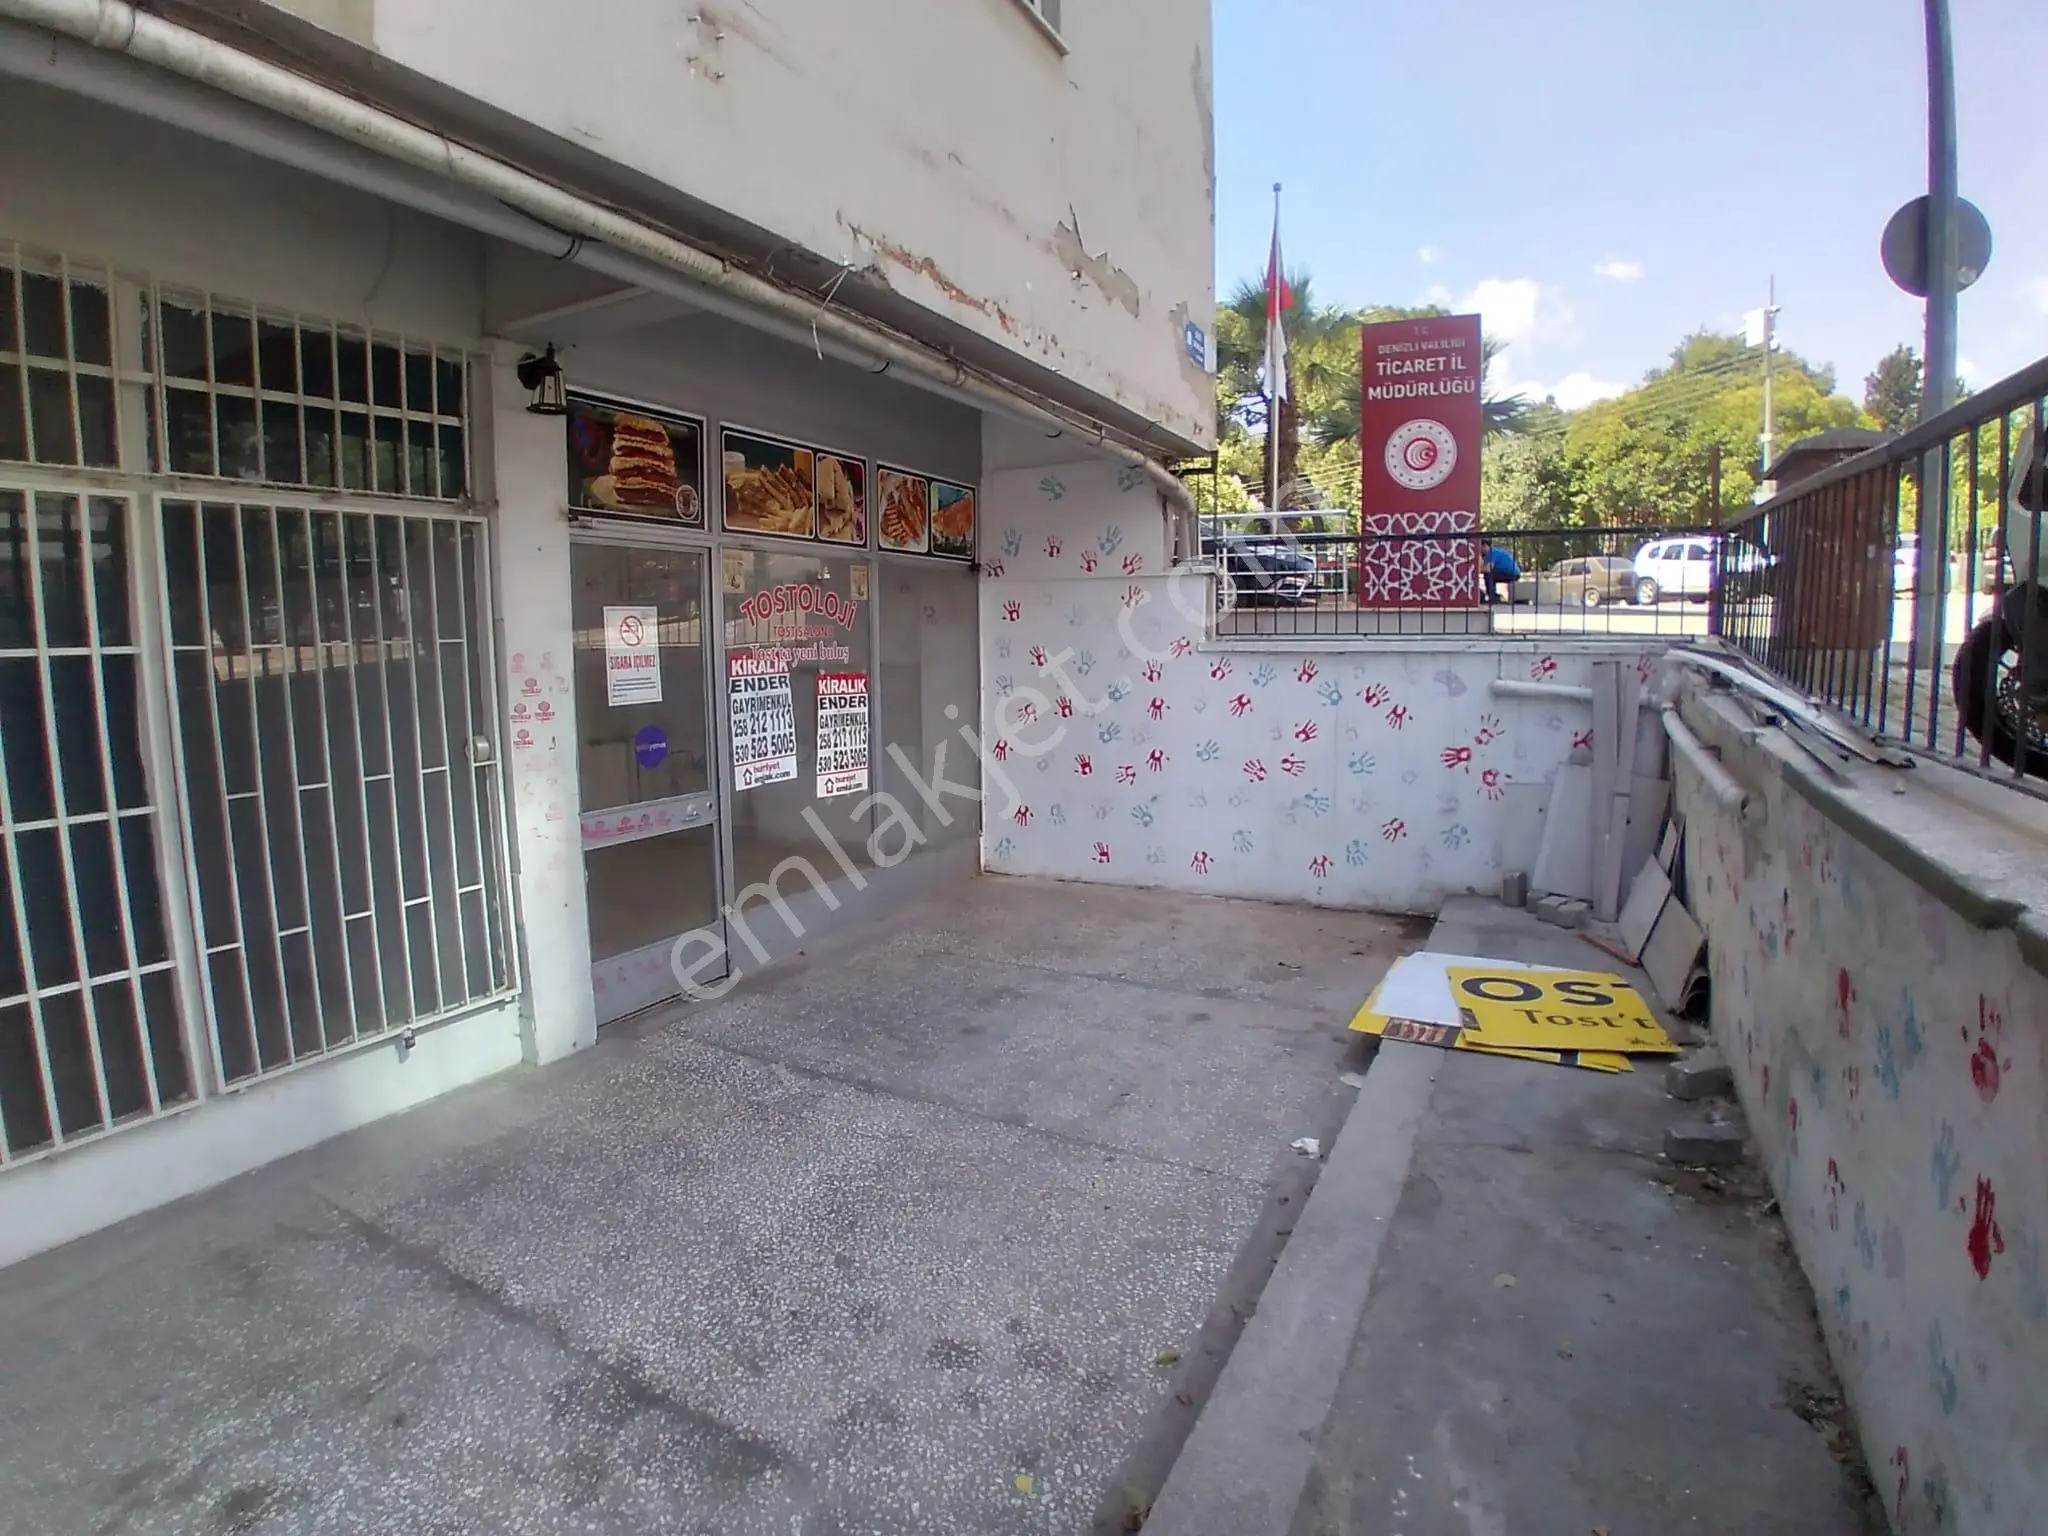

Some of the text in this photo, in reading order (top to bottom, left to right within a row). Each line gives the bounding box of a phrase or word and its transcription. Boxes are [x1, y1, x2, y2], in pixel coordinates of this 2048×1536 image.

[1376, 353, 1467, 376] TİCARET İL
[1368, 376, 1475, 400] MÜDÜRLÜĞÜ
[773, 625, 795, 638] TOST
[610, 653, 632, 669] SİGARA
[731, 655, 790, 675] KİRALIK
[791, 642, 819, 668] yeni
[819, 641, 849, 664] buluş
[730, 676, 789, 693] ENDER
[818, 676, 867, 694] KİRALIK
[733, 692, 791, 715] GAYRİMENKUL
[819, 695, 867, 710] ENDER
[733, 709, 793, 737] 258 212 1113
[735, 733, 795, 763] 530 523 5005
[819, 726, 867, 750] 258 212 1113
[818, 748, 867, 772] 530 523 5005
